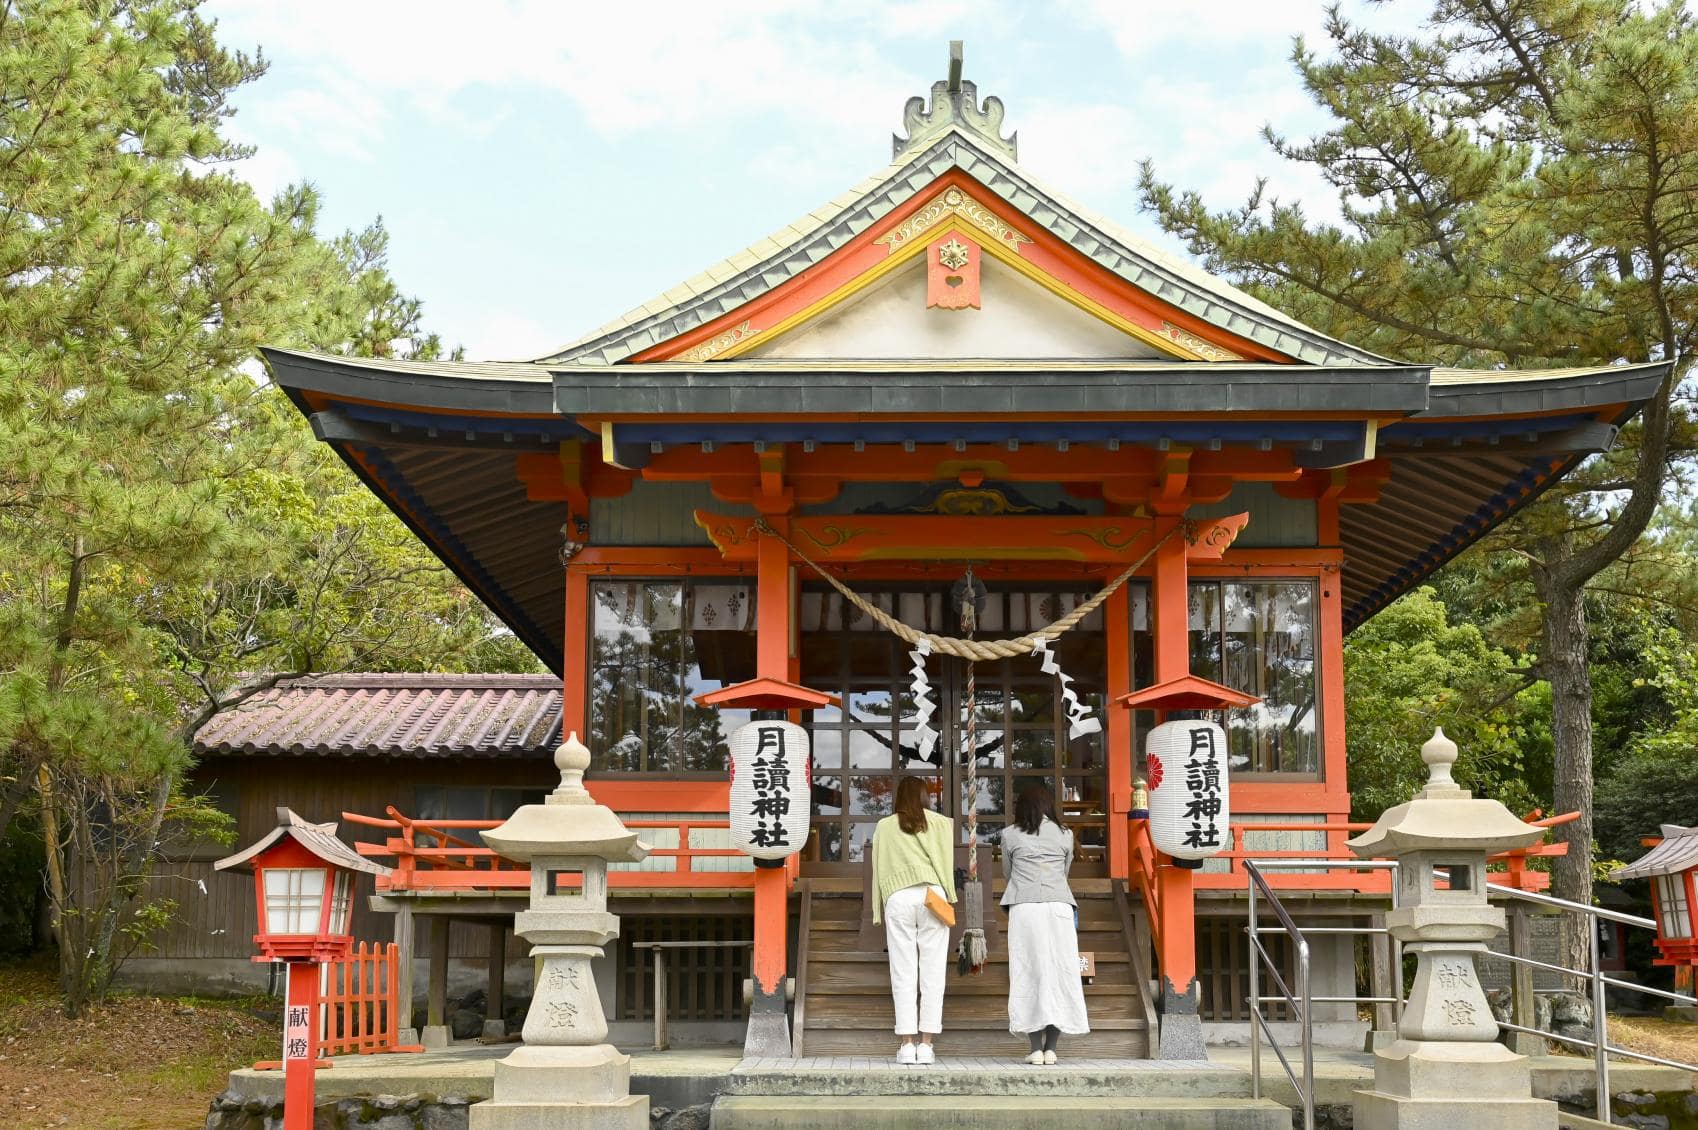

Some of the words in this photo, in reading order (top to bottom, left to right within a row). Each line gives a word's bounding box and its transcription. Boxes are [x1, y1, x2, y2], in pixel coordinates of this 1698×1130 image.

[749, 726, 791, 848] 月讀神社
[1182, 727, 1222, 849] 月讀神社
[288, 1007, 309, 1058] 献燈
